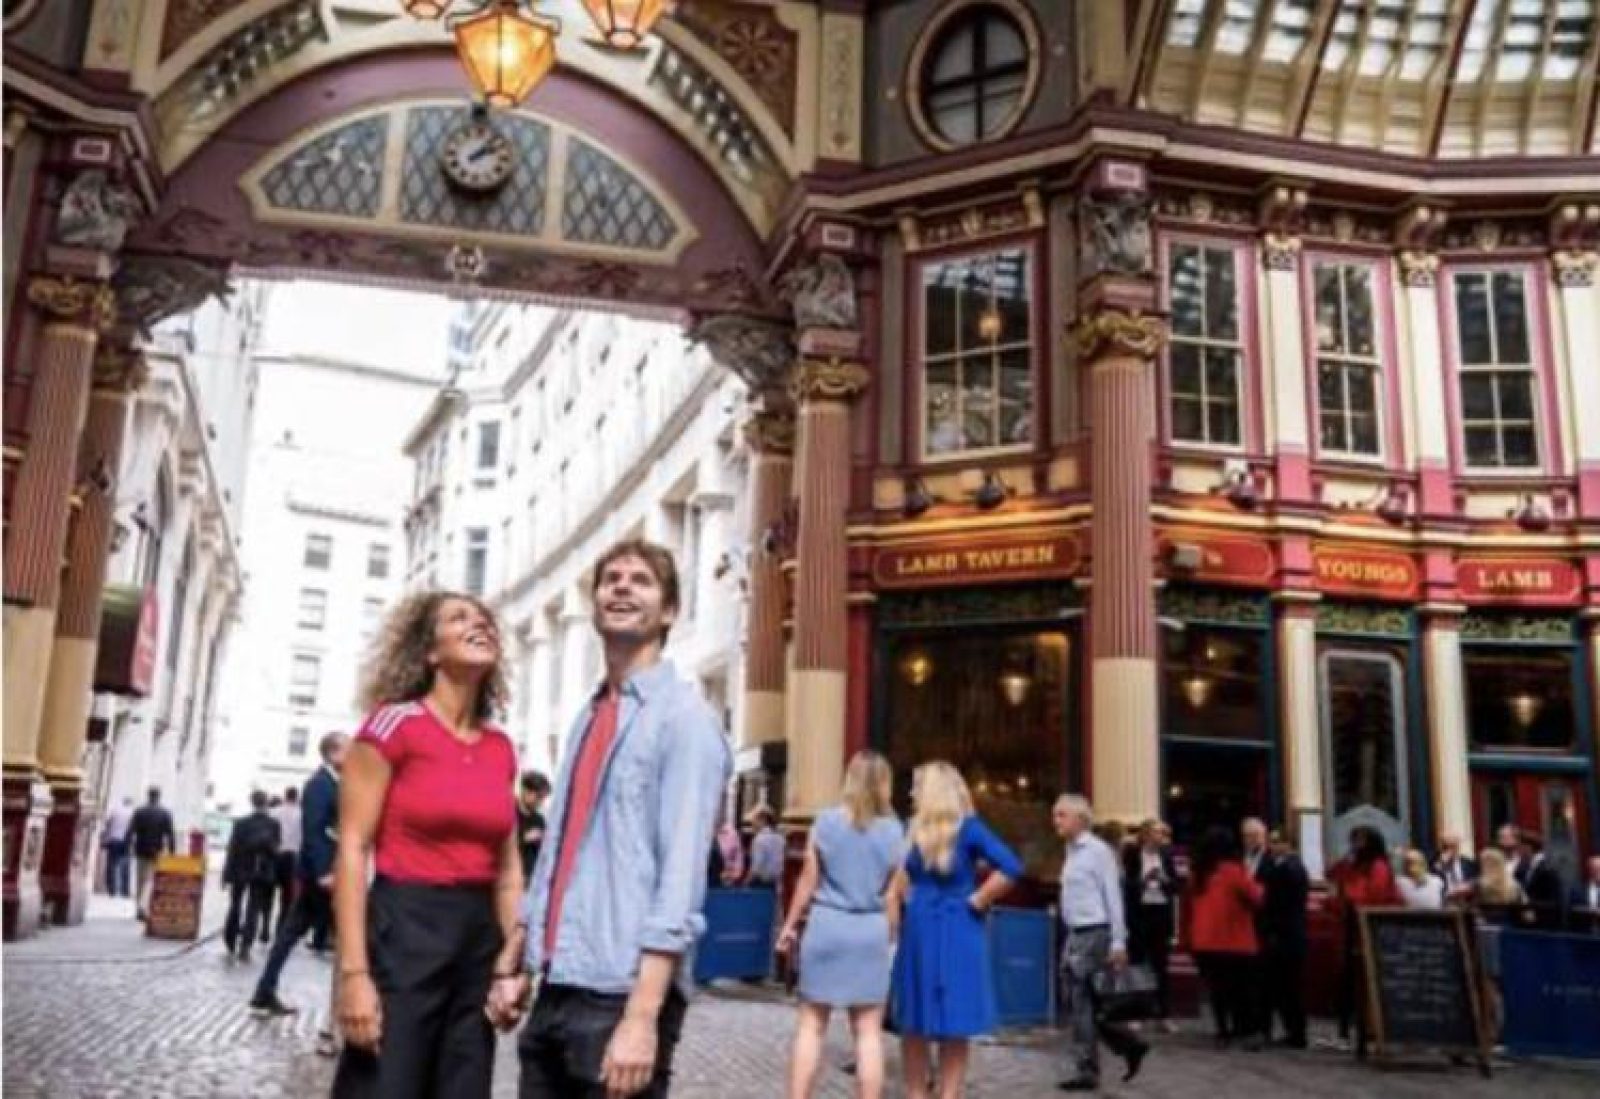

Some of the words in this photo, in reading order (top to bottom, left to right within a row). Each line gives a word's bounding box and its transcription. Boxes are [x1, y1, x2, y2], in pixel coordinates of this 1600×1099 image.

[896, 553, 958, 575] LAMB
[966, 544, 1055, 571] TAVERN
[1477, 569, 1552, 588] LAMB
